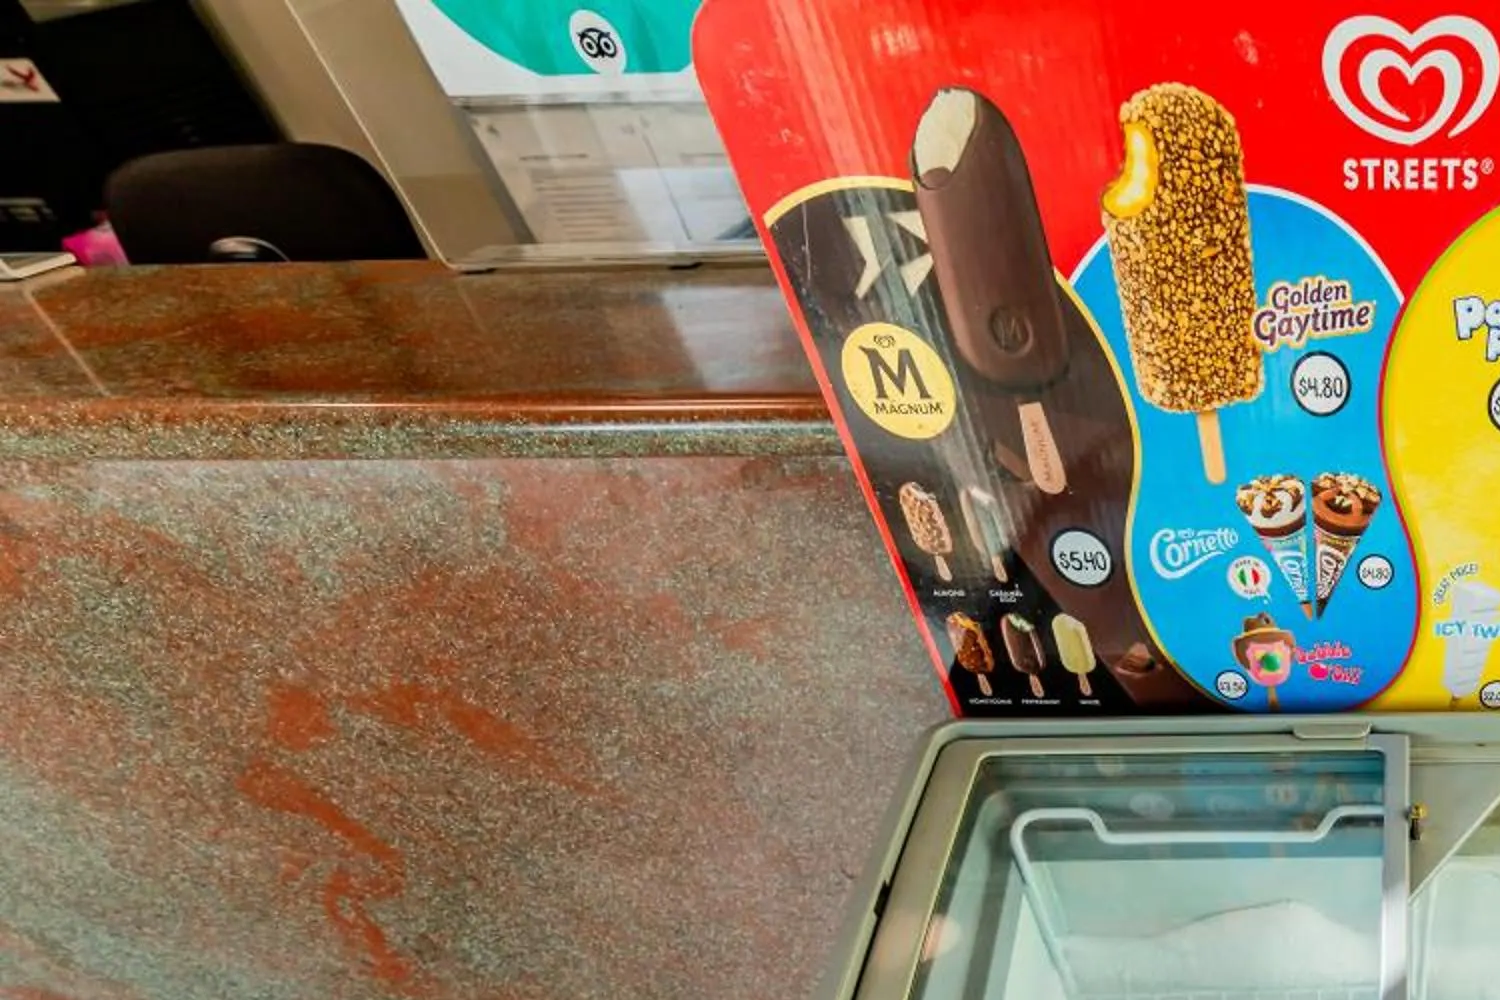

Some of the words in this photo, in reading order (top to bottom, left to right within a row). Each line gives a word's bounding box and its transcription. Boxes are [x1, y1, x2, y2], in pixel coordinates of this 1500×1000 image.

[1271, 280, 1347, 314] Golden
[1253, 305, 1371, 346] Gaytime
[858, 345, 933, 399] M
[1298, 374, 1344, 399] $4.80
[872, 401, 944, 416] MAGNUM
[1058, 551, 1108, 572] $5.40
[1150, 528, 1240, 580] Cornetto
[1434, 619, 1468, 637] ICY
